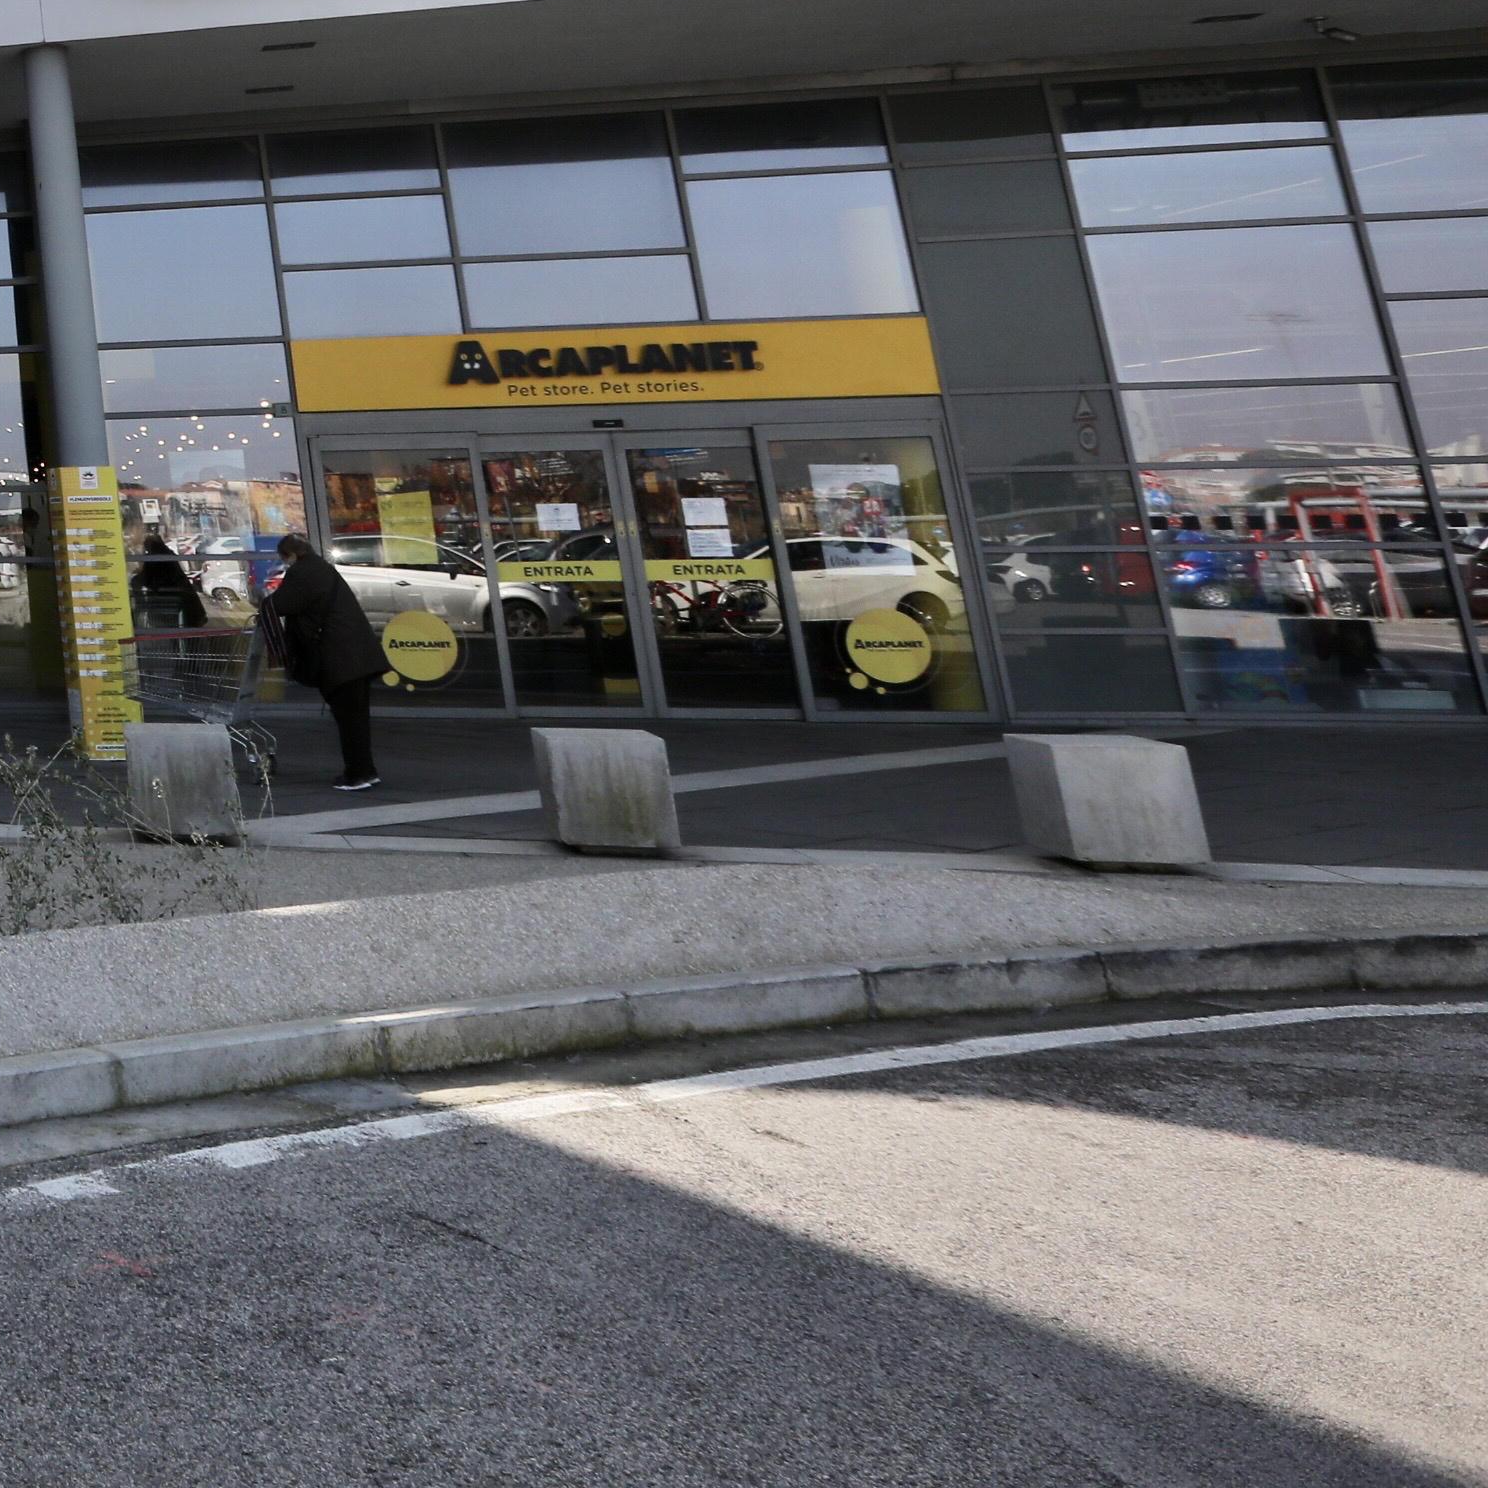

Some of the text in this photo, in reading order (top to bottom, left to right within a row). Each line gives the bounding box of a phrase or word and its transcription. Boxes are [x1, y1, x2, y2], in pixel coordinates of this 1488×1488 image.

[448, 340, 759, 385] ARCAPLANET
[508, 379, 705, 397] Pet store. Pet stories.
[524, 566, 594, 578] ENTRATA
[672, 563, 746, 576] ENTRATA
[388, 638, 451, 649] ARCAPLANET
[854, 638, 925, 649] ARCAPLANET
